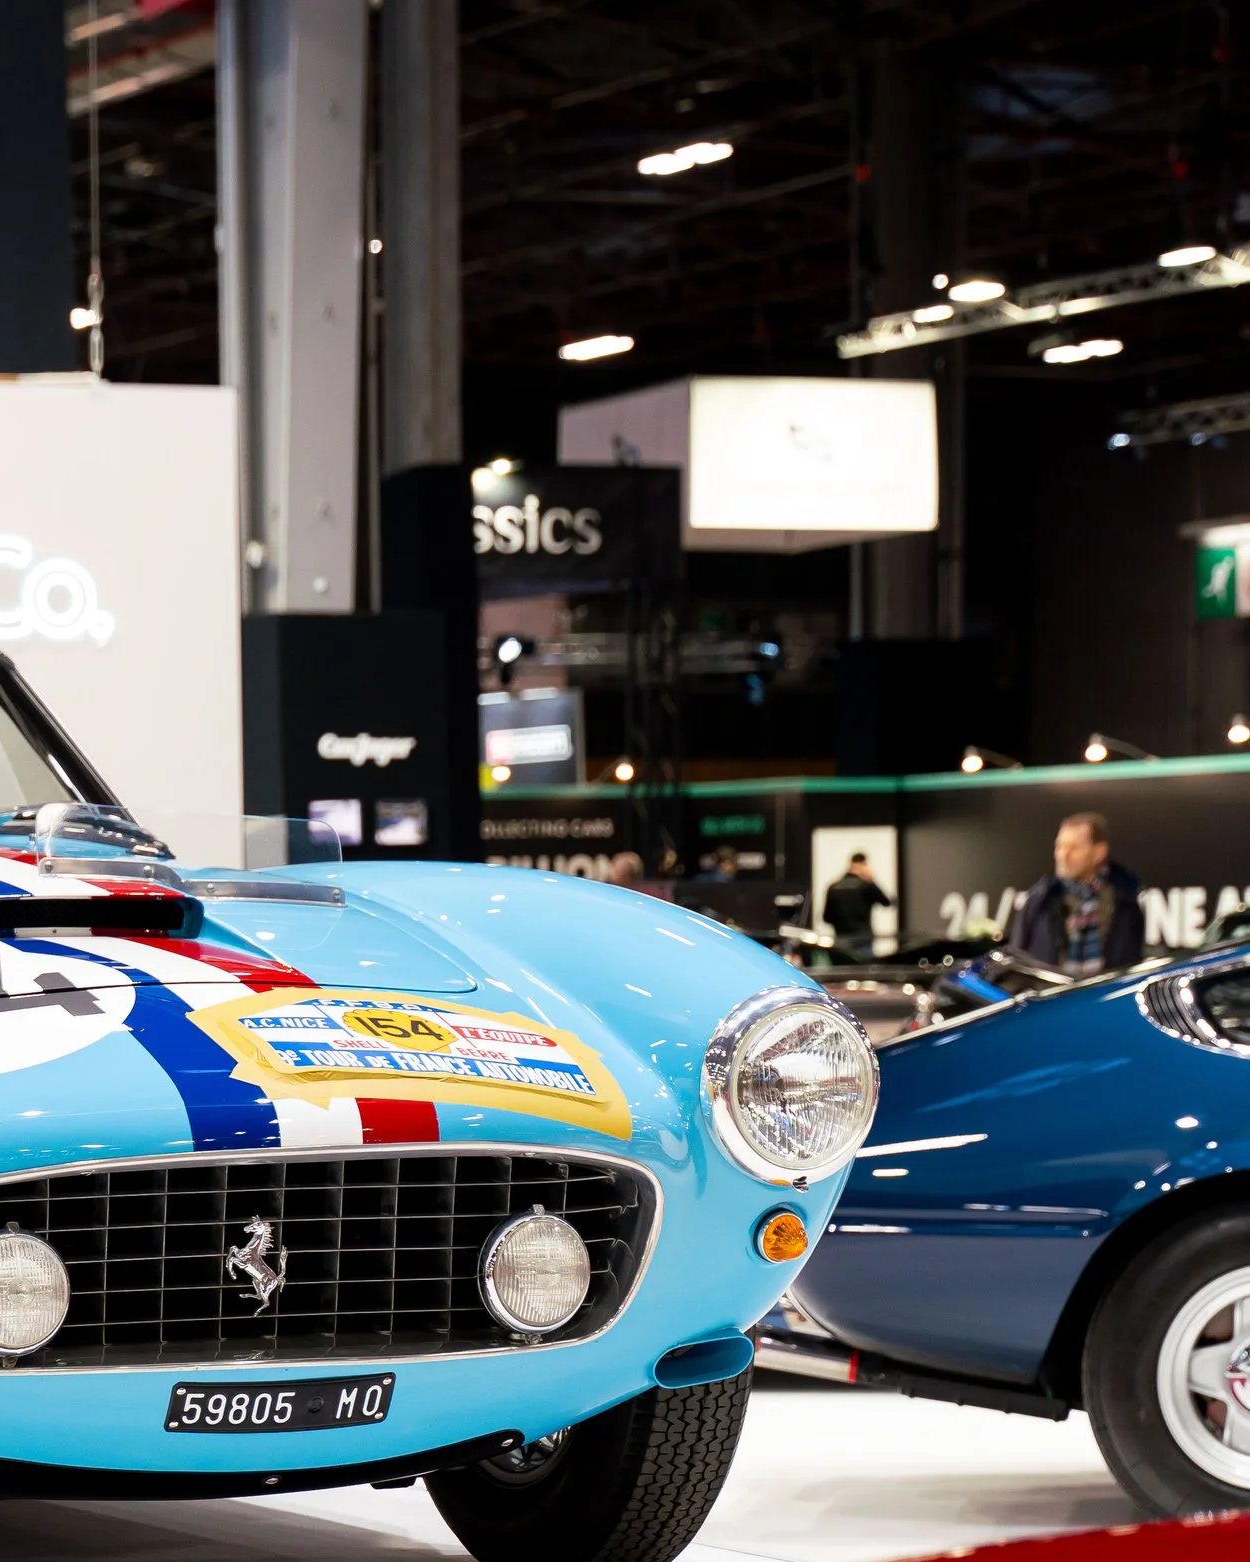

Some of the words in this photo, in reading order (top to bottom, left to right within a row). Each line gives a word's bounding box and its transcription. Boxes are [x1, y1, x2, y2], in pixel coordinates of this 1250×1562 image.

[354, 1016, 445, 1041] 154
[333, 1040, 389, 1049] SHELL
[300, 1050, 364, 1068] TOUR
[391, 1053, 477, 1075] FRANCE
[475, 1060, 596, 1095] AUTOMOBILE
[181, 1392, 296, 1425] 59805
